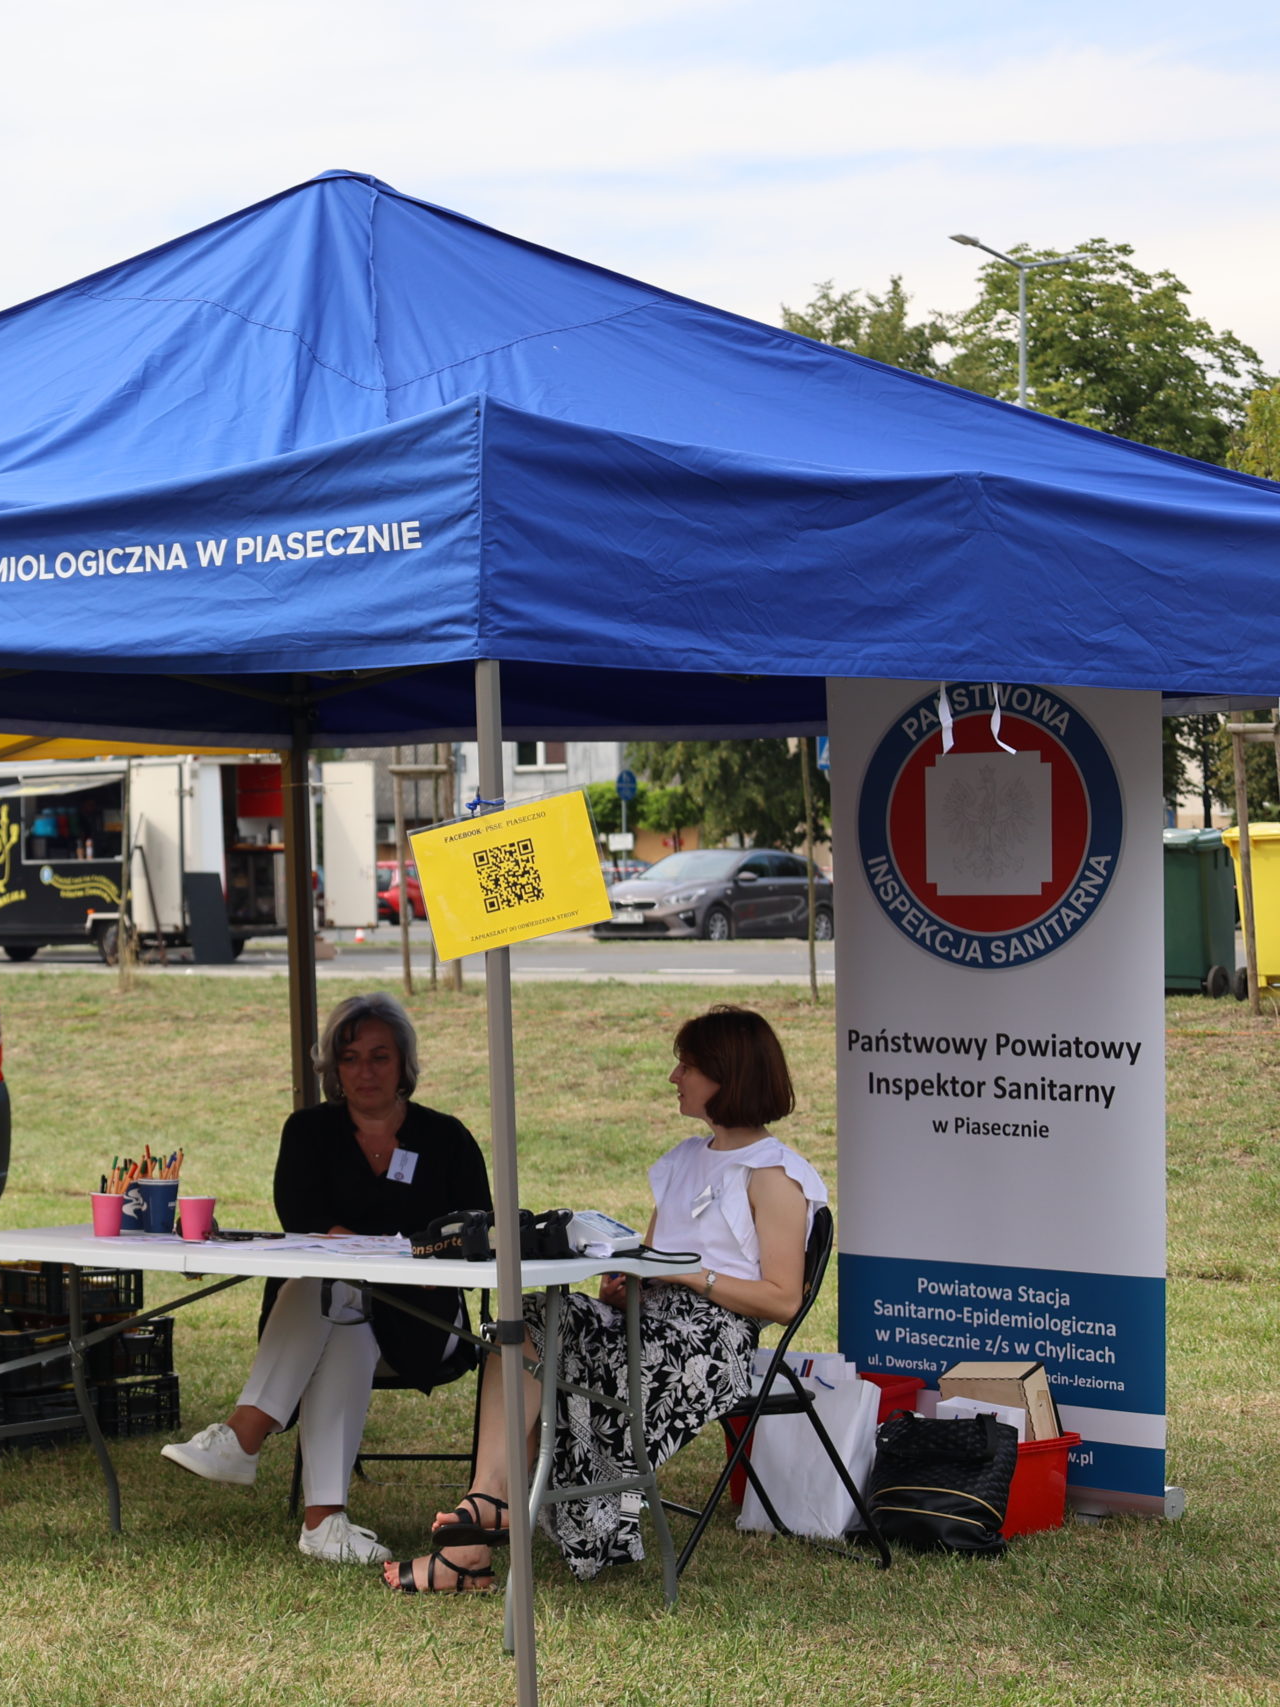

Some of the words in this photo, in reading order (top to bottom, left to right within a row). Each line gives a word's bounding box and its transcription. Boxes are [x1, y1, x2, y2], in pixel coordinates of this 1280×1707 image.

[195, 539, 227, 568] W
[236, 520, 422, 565] PIASECZNIE
[485, 822, 503, 833] PSSE
[506, 811, 547, 827] PIASECZNO
[867, 855, 983, 963] INSPEKCJA
[990, 854, 1112, 963] SANITARNA
[847, 1029, 987, 1061] Państwowy
[995, 1033, 1142, 1066] Powiatowy
[868, 1072, 986, 1101] Inspektor
[993, 1076, 1116, 1109] Sanitarny
[932, 1119, 949, 1134] w
[954, 1117, 1050, 1138] Piasecznie
[917, 1277, 1013, 1301] Powiatowa
[1018, 1285, 1070, 1307] Stacja
[873, 1299, 1117, 1337] Sanitarno-Epidemiologiczna
[867, 1353, 882, 1367] ul.
[885, 1355, 937, 1372] Dworska
[940, 1360, 948, 1372] 7
[875, 1329, 890, 1342] w
[895, 1327, 981, 1350] Piasecznie
[985, 1335, 1010, 1355] z/s
[1014, 1342, 1030, 1355] w
[1034, 1340, 1116, 1364] Chylicach
